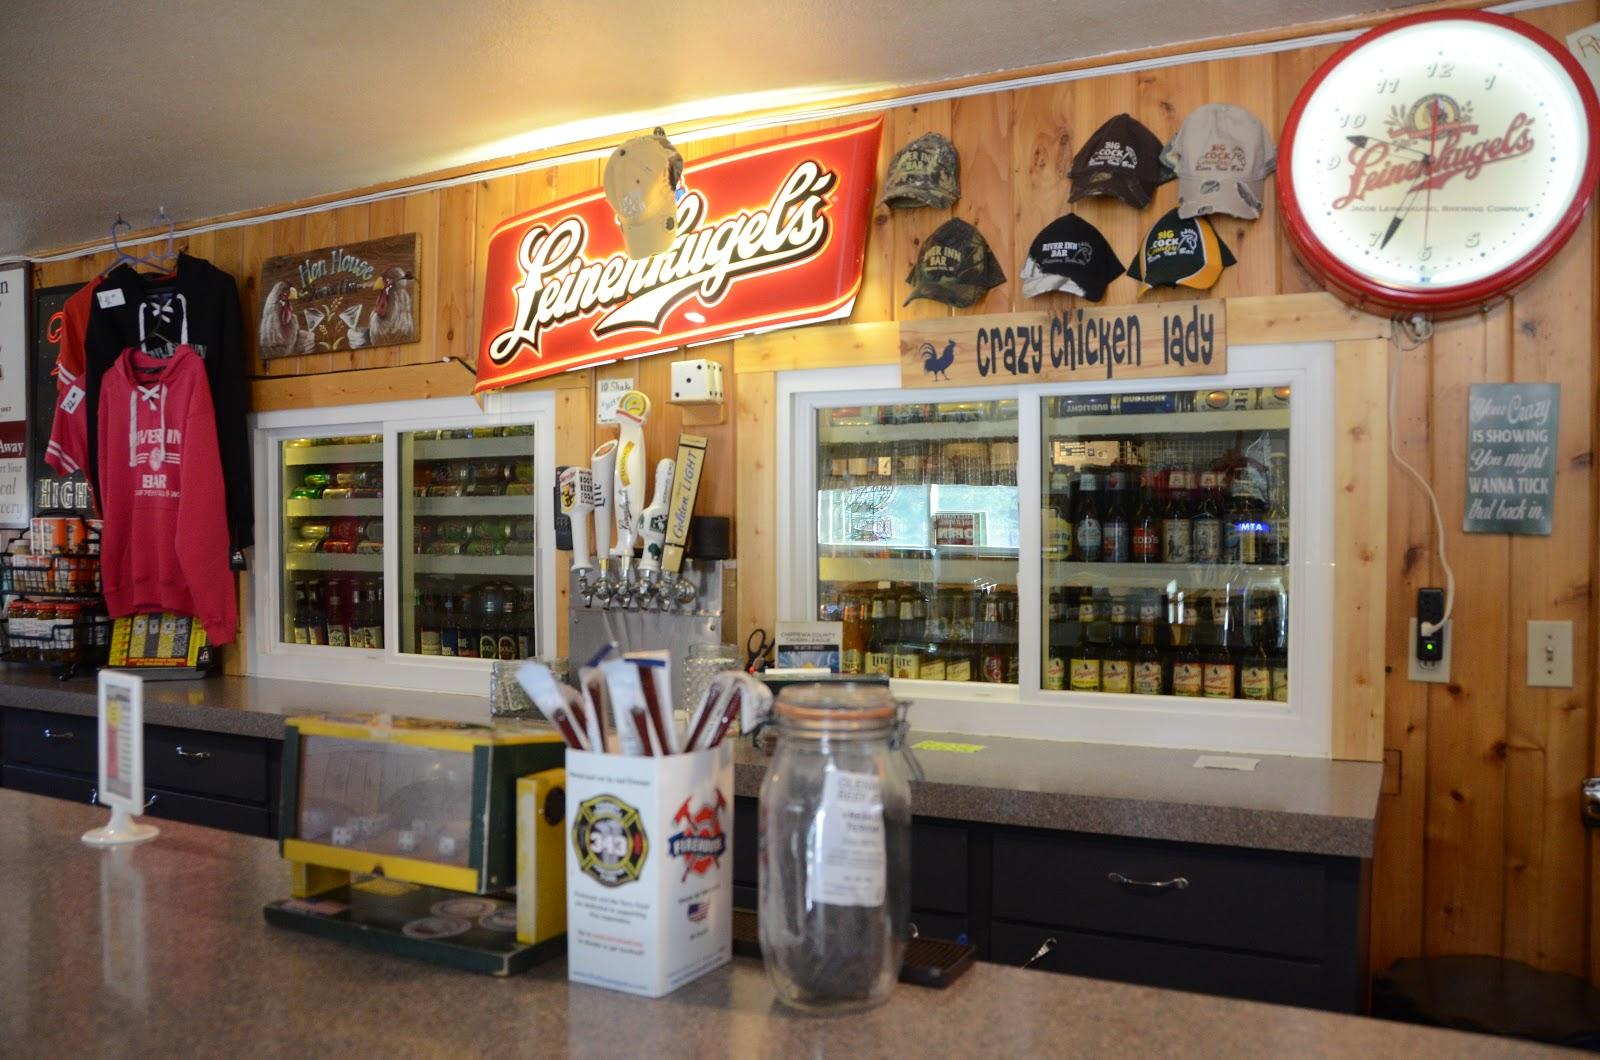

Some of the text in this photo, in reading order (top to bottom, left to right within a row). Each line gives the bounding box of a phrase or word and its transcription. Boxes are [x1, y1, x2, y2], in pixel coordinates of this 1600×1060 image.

[1426, 63, 1455, 78] 12
[1376, 79, 1399, 94] 11
[1484, 75, 1496, 90] 1
[1340, 114, 1367, 128] 10
[1098, 148, 1124, 157] COCK
[1104, 141, 1121, 149] BIG
[1204, 151, 1231, 160] COCK
[1332, 112, 1536, 210] Leinenkugel's
[1157, 230, 1175, 240] BIG
[1152, 237, 1180, 249] COCK
[1050, 249, 1069, 258] BAR
[298, 248, 375, 288] Hen House
[488, 160, 838, 365] Leinenkugel's
[929, 256, 948, 267] BAR
[976, 324, 1044, 378] crazy
[1162, 304, 1215, 367] lady
[1507, 394, 1552, 427] Crazy
[1472, 428, 1549, 443] IS SHOWING
[1469, 446, 1550, 475] You might
[142, 474, 167, 489] BAR
[1468, 476, 1550, 495] WANNA TUCK
[39, 478, 89, 509] HIGH
[672, 449, 698, 540] Golden LIGHT
[1468, 498, 1498, 520] that
[1495, 498, 1528, 521] back
[872, 654, 890, 667] Lite
